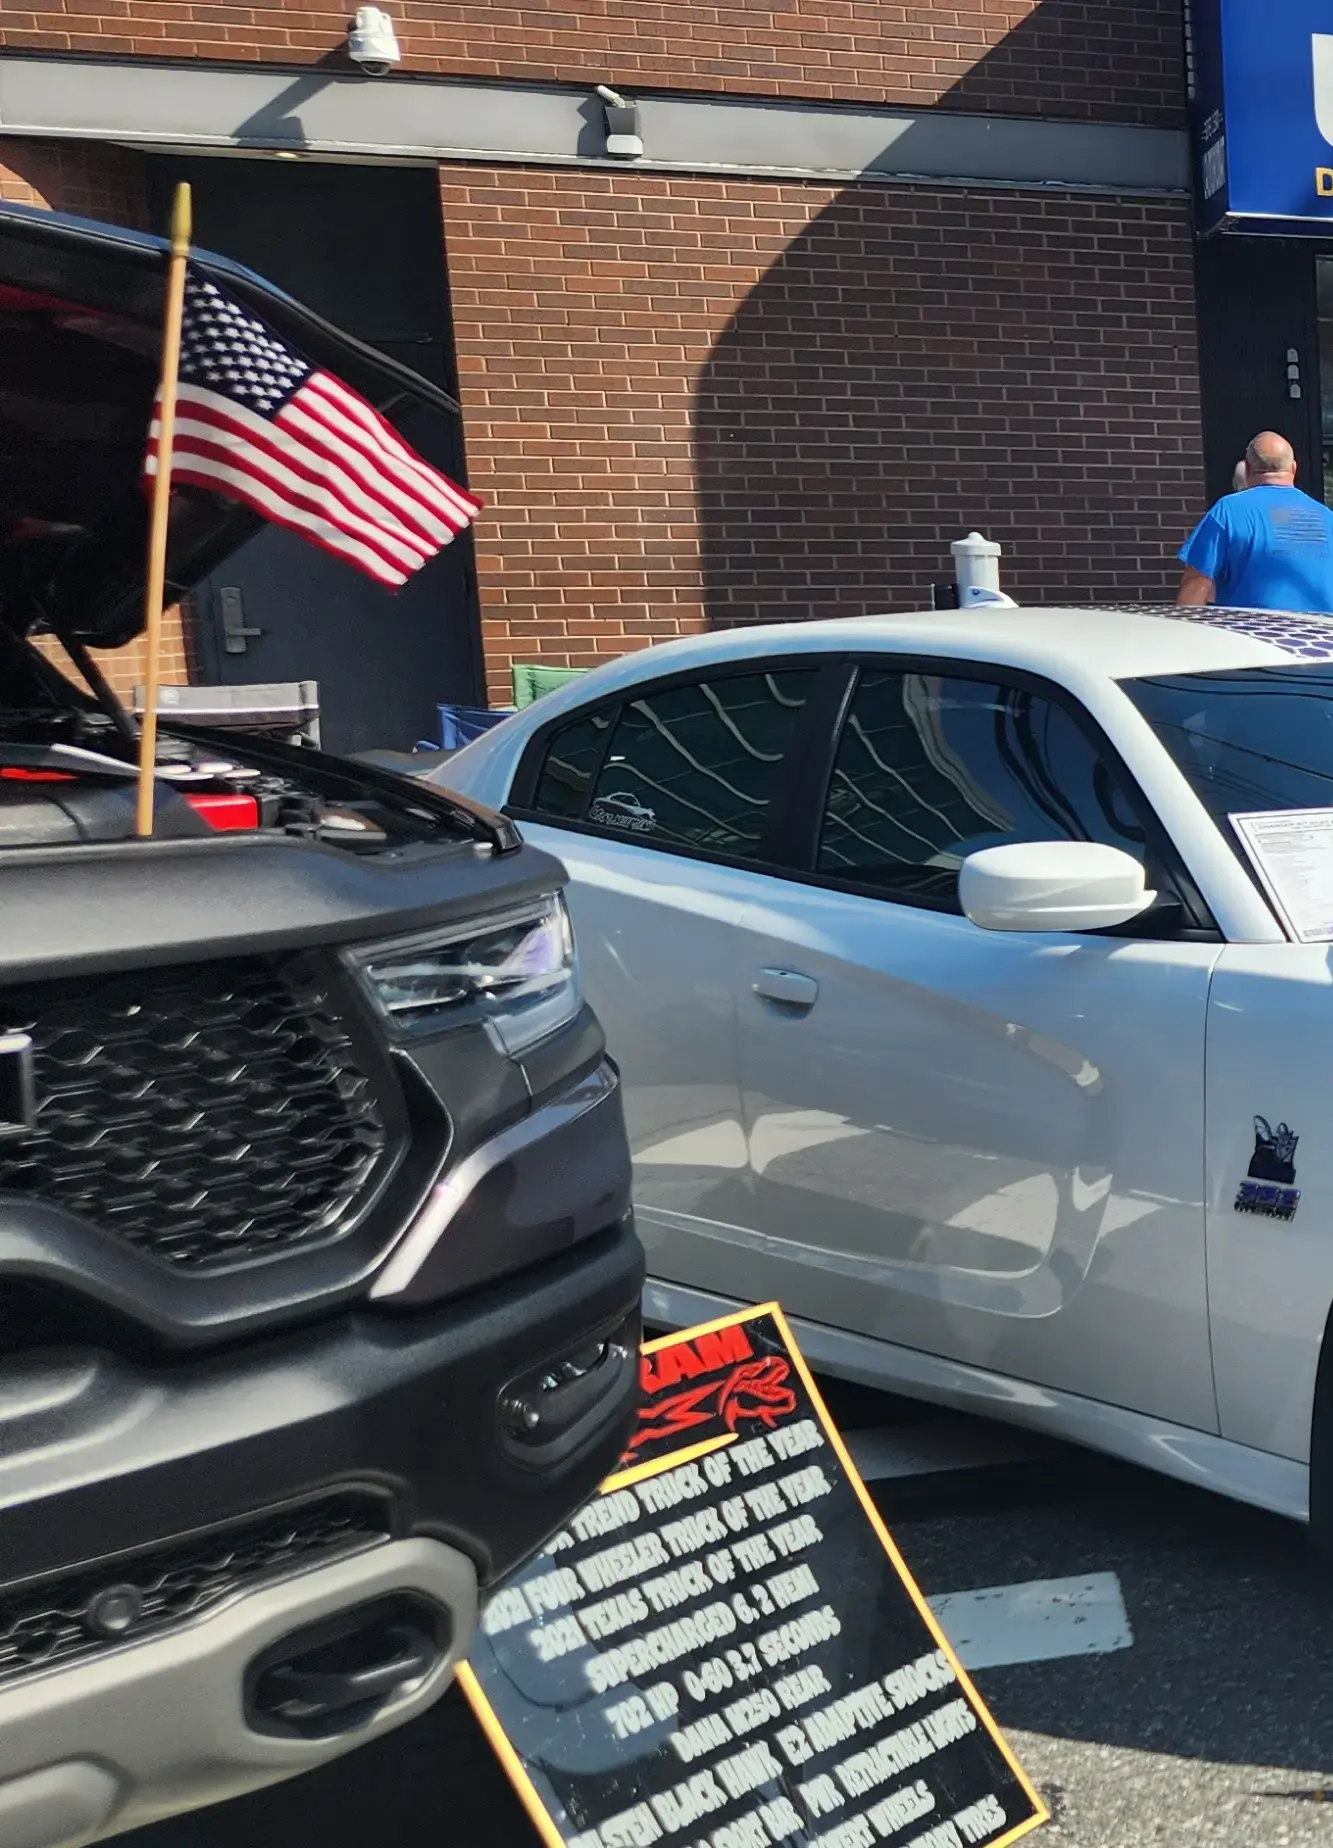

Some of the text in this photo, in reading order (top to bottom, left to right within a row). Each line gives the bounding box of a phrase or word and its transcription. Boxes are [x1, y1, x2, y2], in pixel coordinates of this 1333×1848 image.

[523, 1567, 586, 1615] FOUR
[575, 1531, 671, 1593] WHEELER
[660, 1505, 729, 1559] TRUCK
[722, 1495, 752, 1534] OF
[742, 1483, 789, 1522] THE
[780, 1465, 833, 1507] YEAR
[571, 1419, 825, 1542] TREND TRUCK OF THE YEAR
[530, 1514, 824, 1664] 2021 TEXAS TRUCK OF THE YEAR
[584, 1600, 738, 1694] SUPERCHARGED
[767, 1562, 821, 1610] HEMI
[604, 1694, 657, 1740] 702
[642, 1680, 680, 1723] HP
[756, 1604, 842, 1668] SECONDS
[668, 1713, 734, 1764] DANA
[772, 1664, 833, 1711] REAR
[651, 1768, 729, 1834] BLACK
[712, 1739, 784, 1800] HAWK
[801, 1680, 896, 1754] ADAPTIVE
[883, 1648, 957, 1712] SHOCKS
[757, 1795, 806, 1842] BAR
[831, 1721, 937, 1799] RETRACTABLE
[864, 1778, 936, 1838] WHEELS
[951, 1793, 1008, 1844] TIRES
